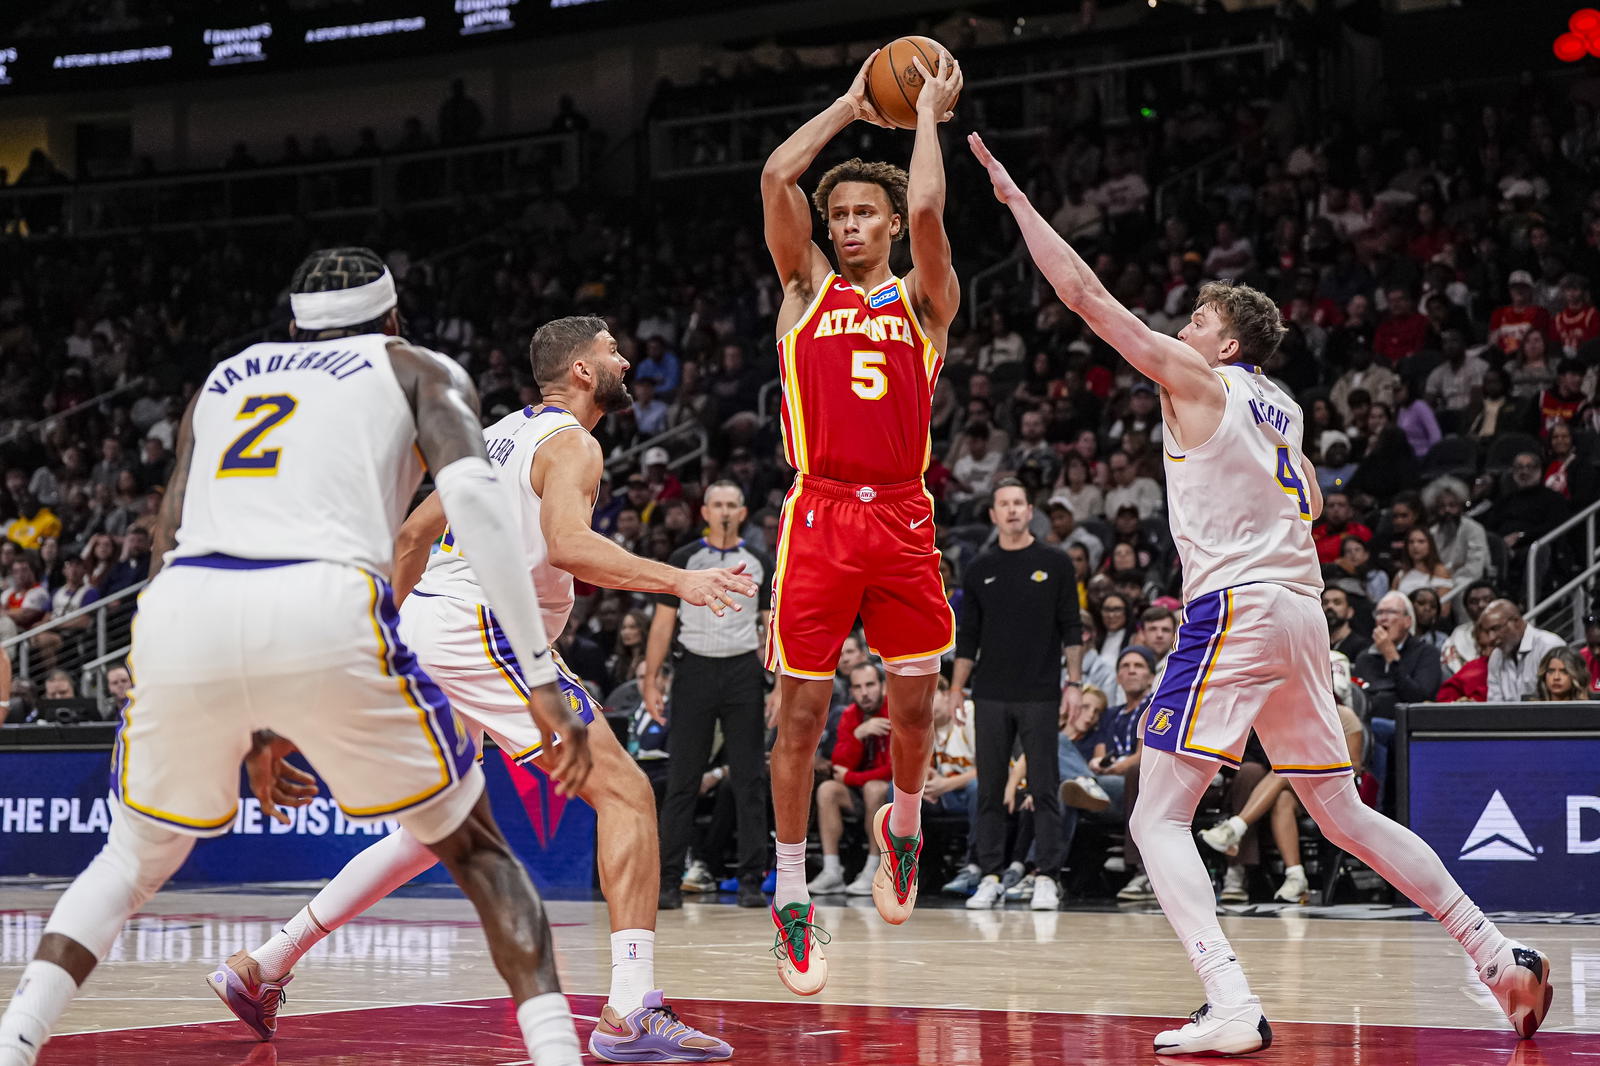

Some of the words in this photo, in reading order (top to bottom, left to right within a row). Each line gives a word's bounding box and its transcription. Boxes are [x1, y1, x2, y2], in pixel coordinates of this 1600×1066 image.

[813, 308, 915, 348] ATLANTA
[208, 350, 374, 395] VANDERBILT
[851, 350, 888, 401] 5
[215, 392, 299, 479] 2
[1274, 444, 1313, 521] 4
